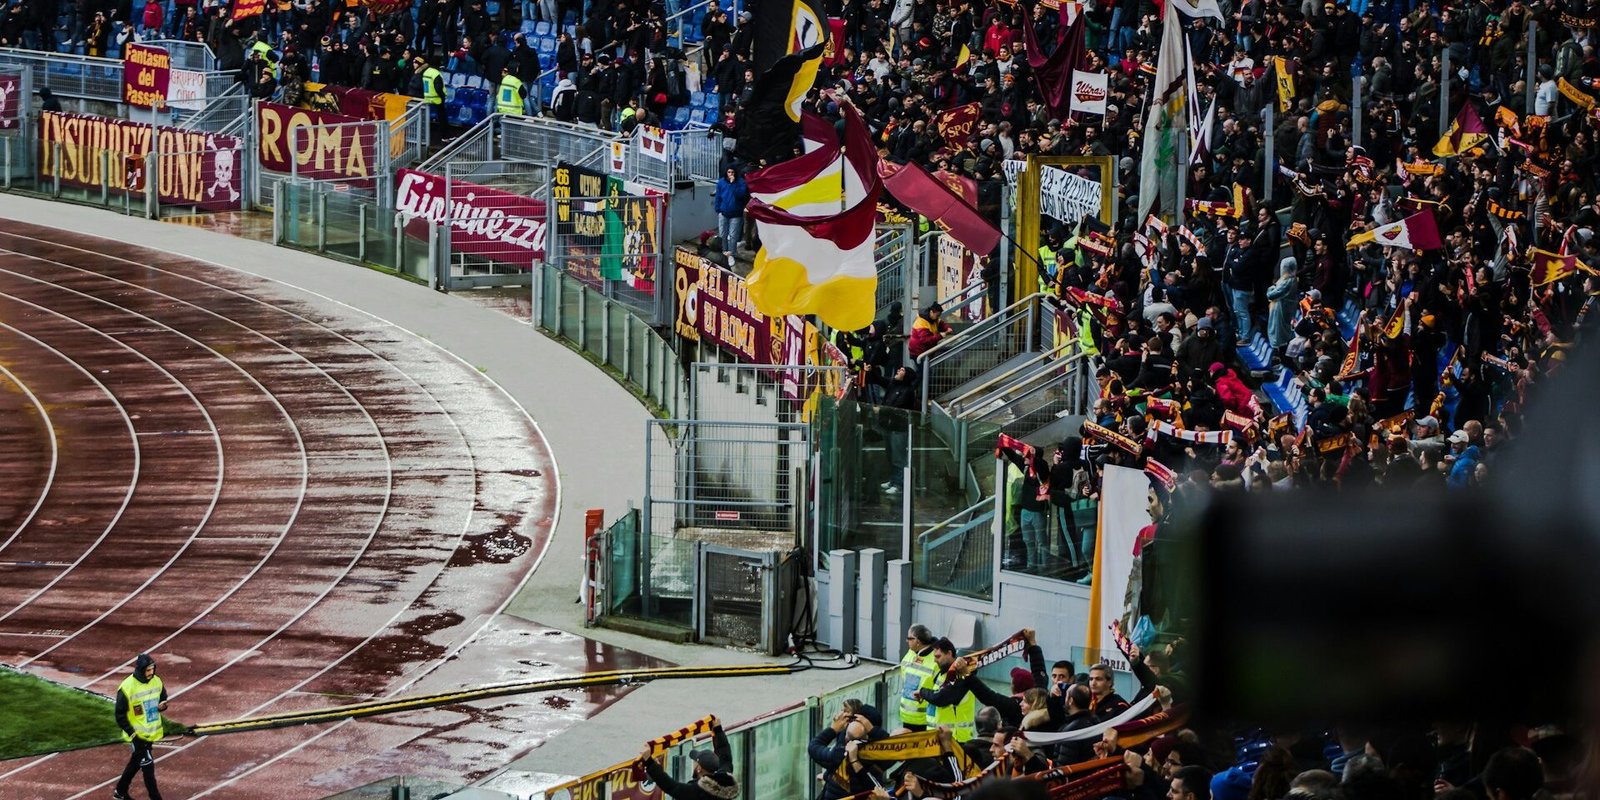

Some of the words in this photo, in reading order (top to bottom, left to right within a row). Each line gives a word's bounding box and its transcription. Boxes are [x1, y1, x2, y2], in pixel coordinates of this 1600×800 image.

[126, 83, 165, 109] Passato
[138, 67, 156, 88] del
[42, 111, 205, 202] INSURREZONE
[261, 110, 368, 180] ROMA
[720, 310, 755, 360] ROMA
[983, 639, 1025, 666] CAPITANO
